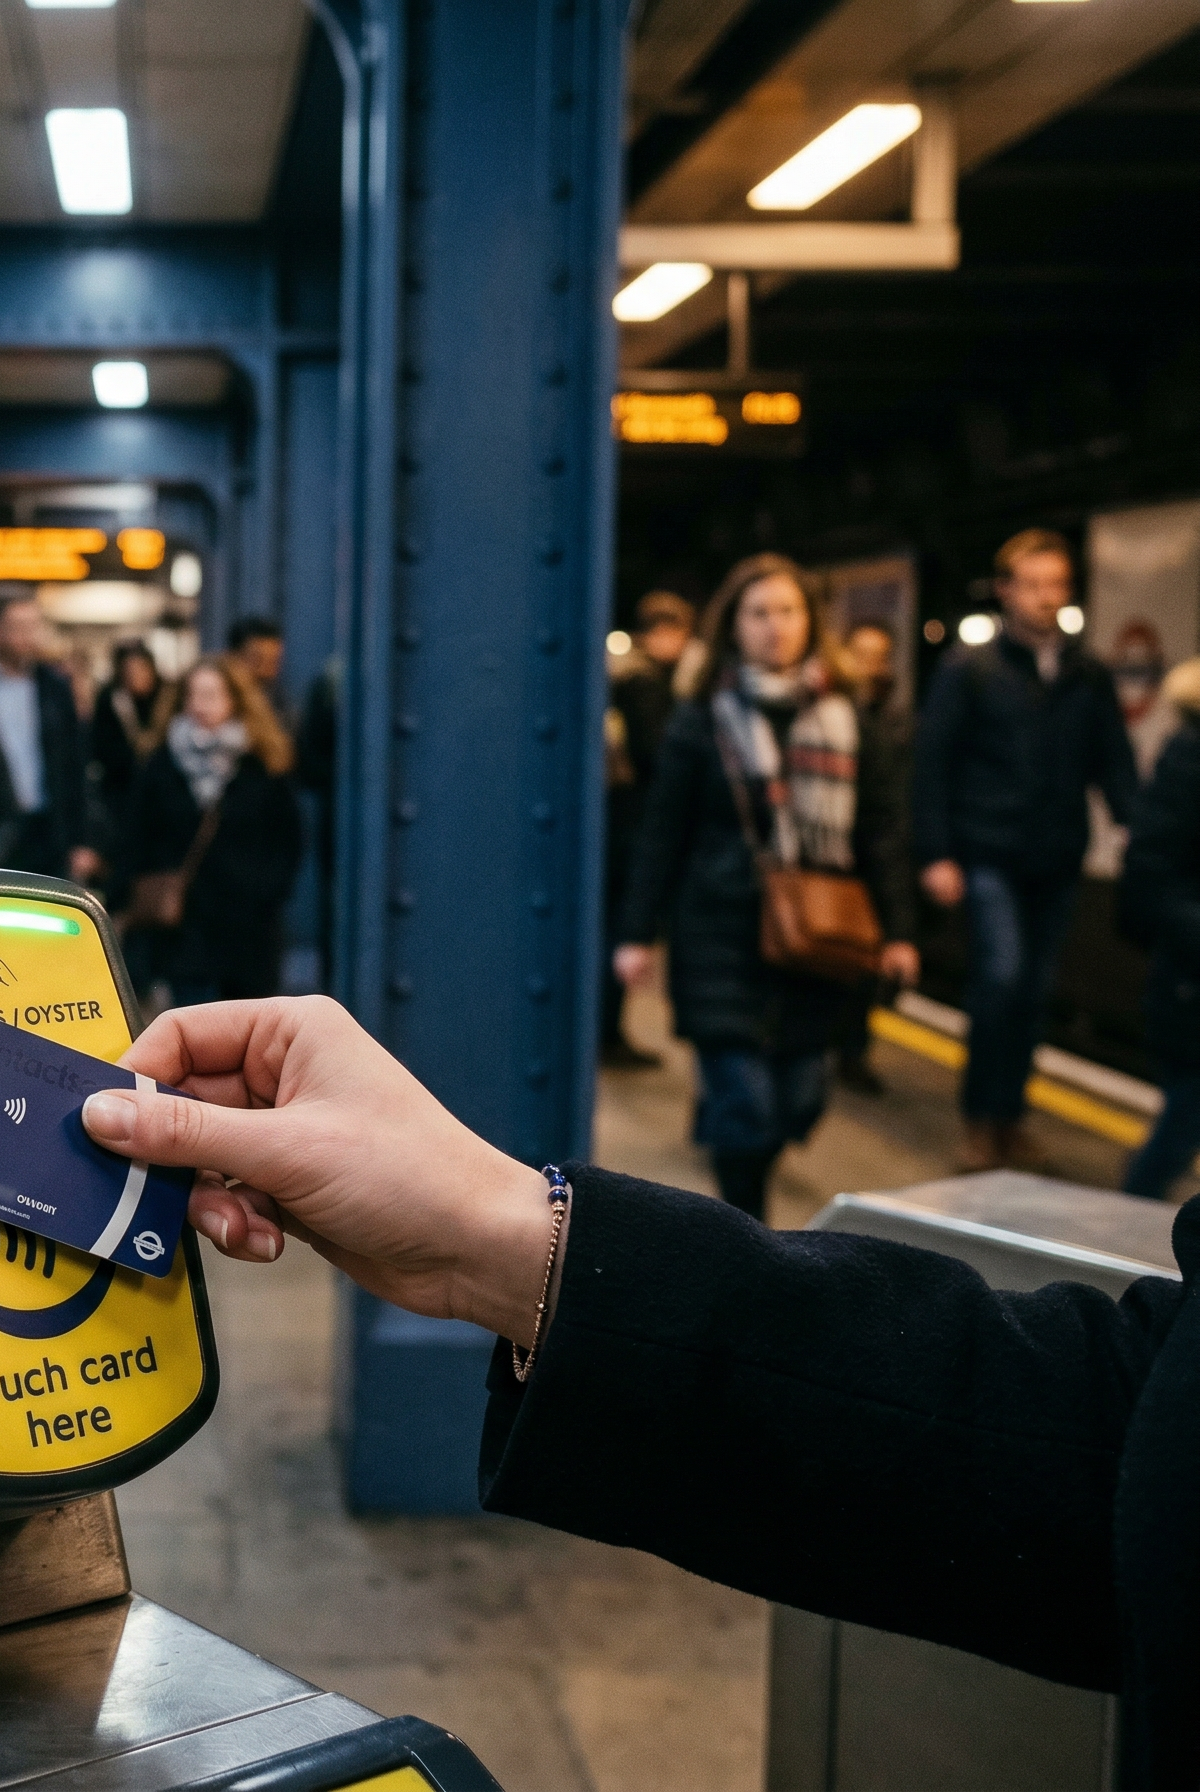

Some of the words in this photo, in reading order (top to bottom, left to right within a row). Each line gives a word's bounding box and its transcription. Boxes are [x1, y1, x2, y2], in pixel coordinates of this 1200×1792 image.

[24, 1000, 103, 1026] OYSTER
[80, 1335, 158, 1386] card
[26, 1405, 112, 1448] here
